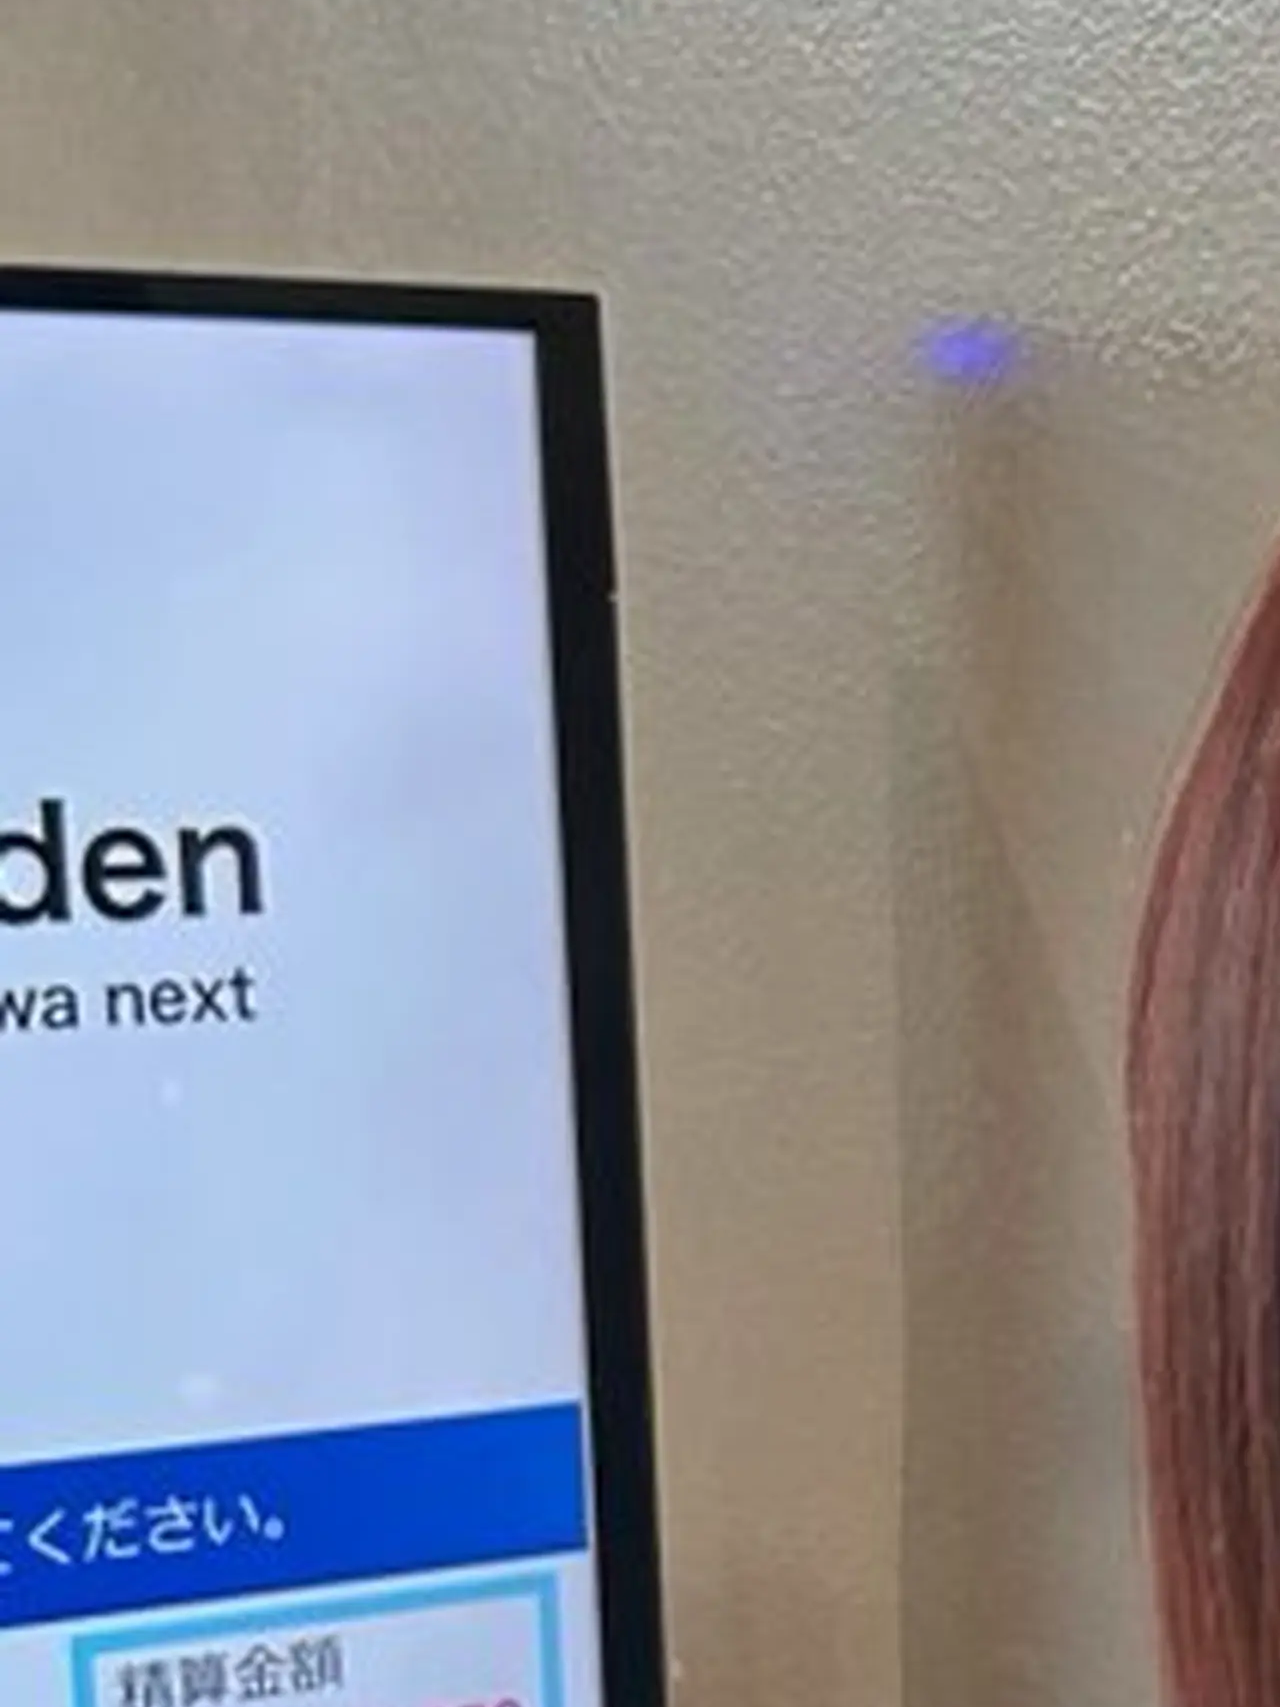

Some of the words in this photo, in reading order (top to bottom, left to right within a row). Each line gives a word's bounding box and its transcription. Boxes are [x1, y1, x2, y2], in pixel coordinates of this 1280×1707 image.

[105, 967, 258, 1026] next
[0, 1493, 285, 1577] ください。
